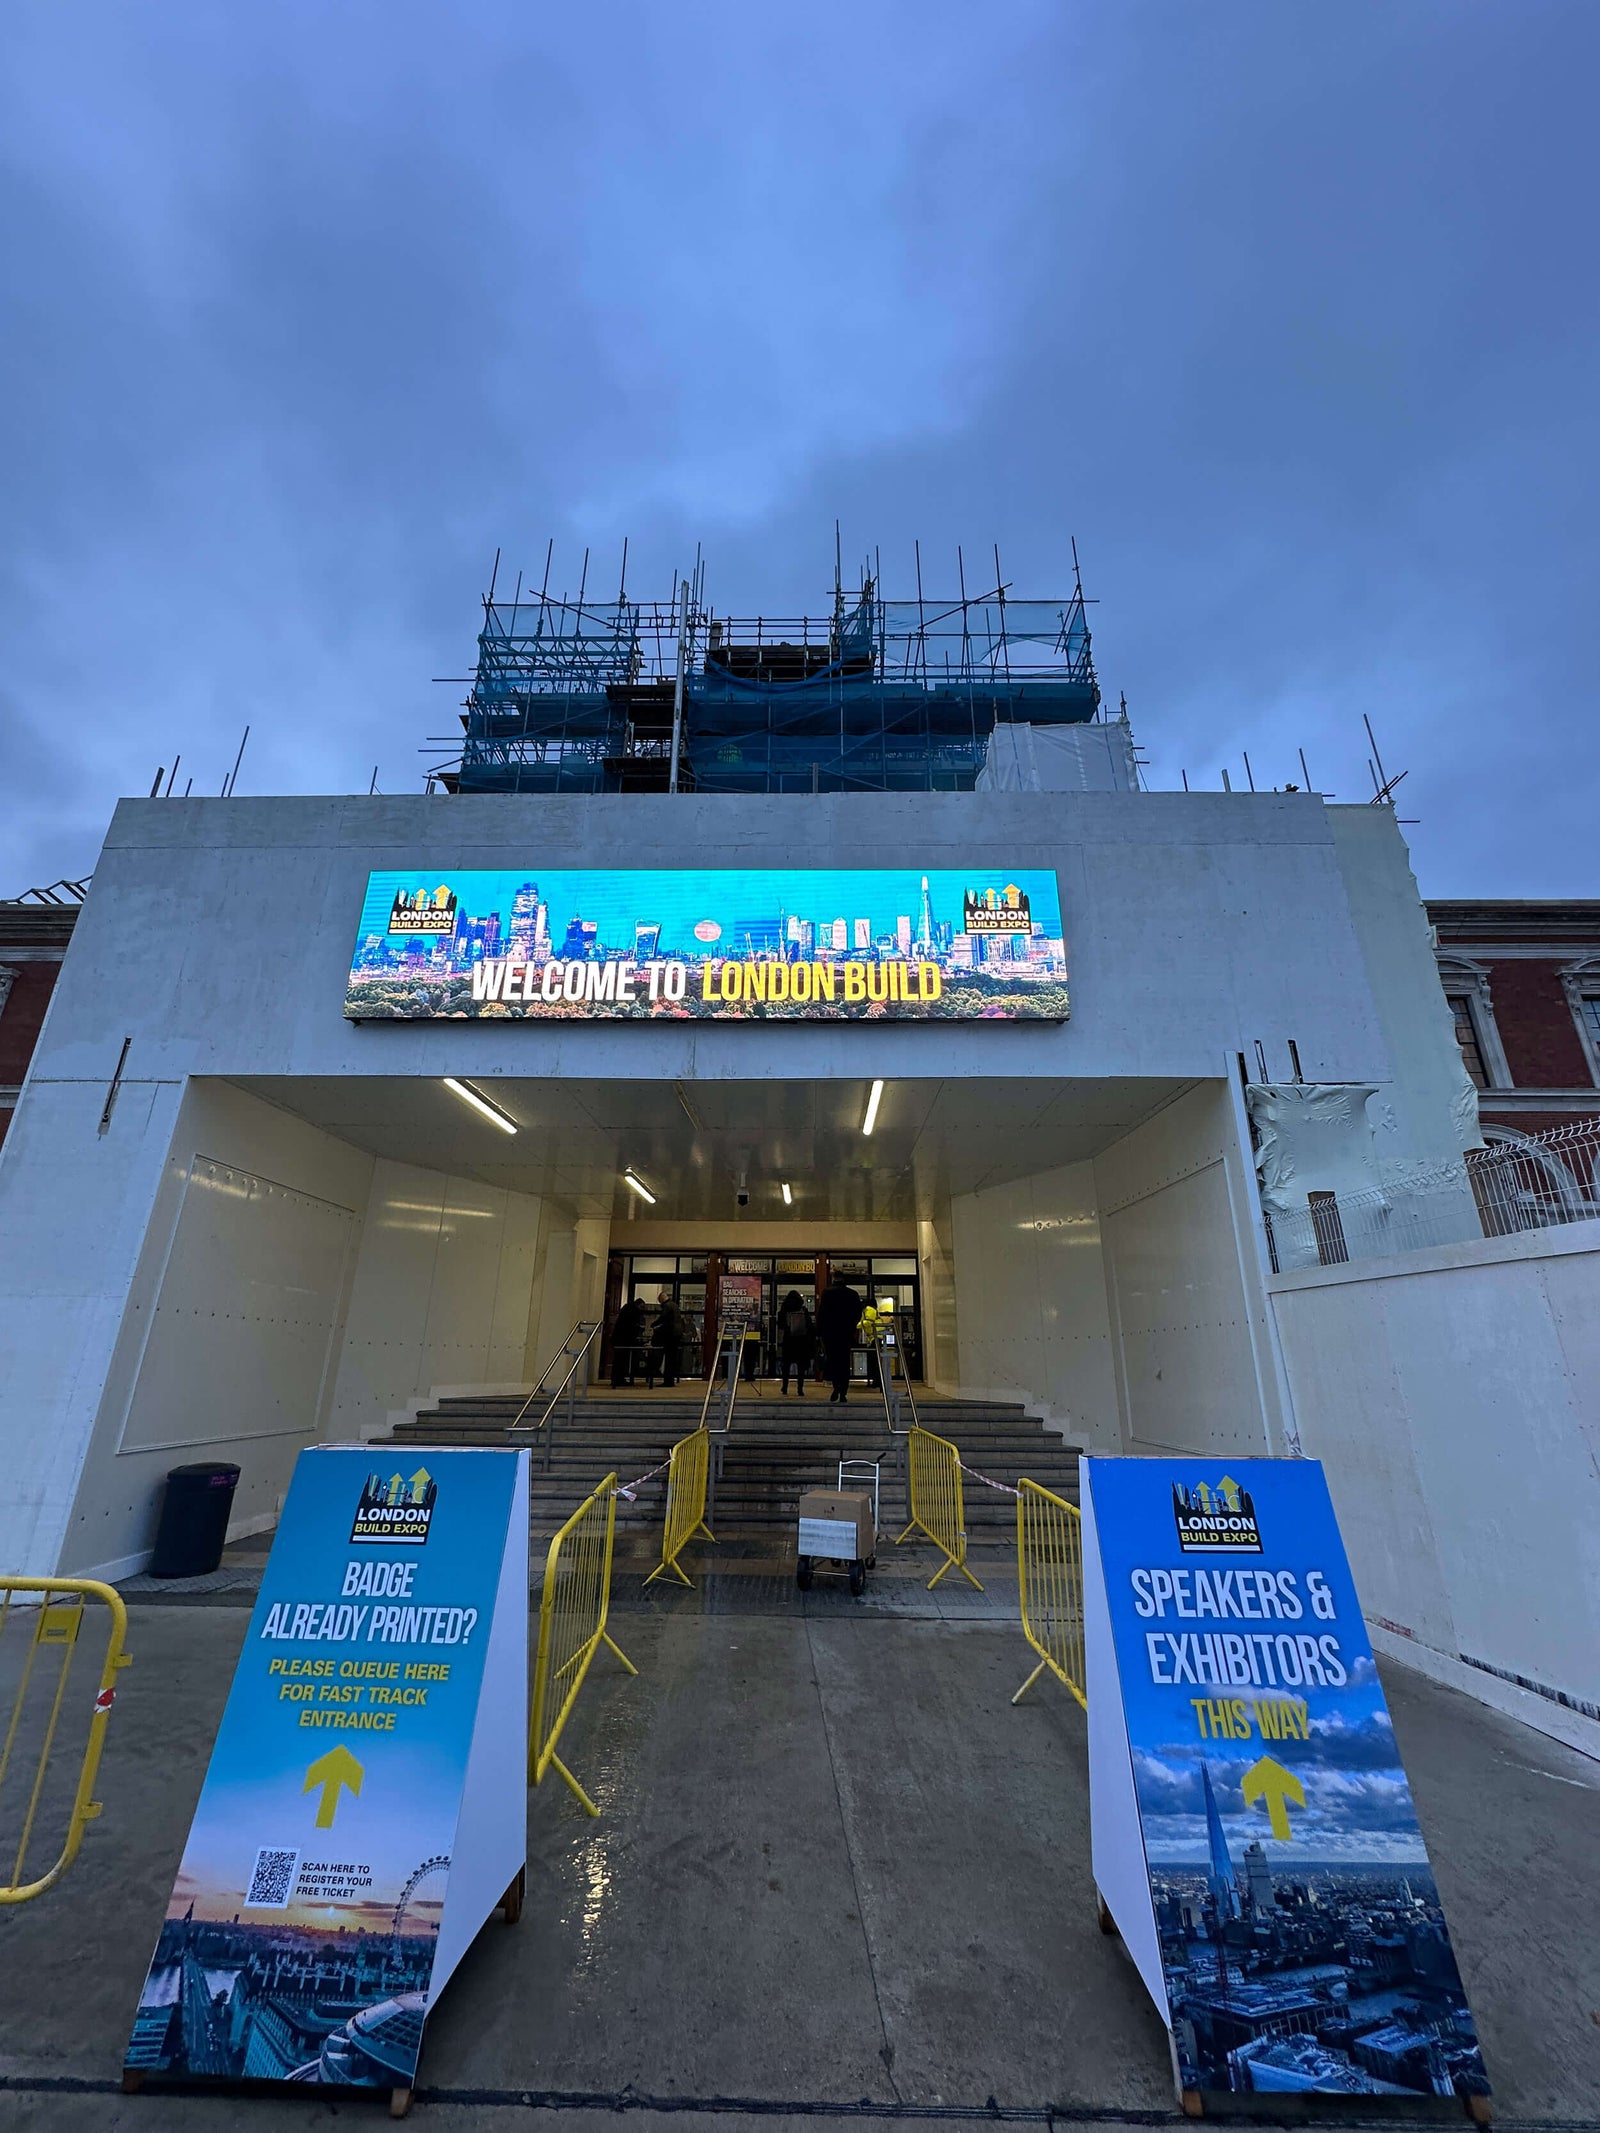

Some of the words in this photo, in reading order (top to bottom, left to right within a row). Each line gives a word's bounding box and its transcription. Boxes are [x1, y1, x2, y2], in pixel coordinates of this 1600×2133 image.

[392, 911, 454, 920] LONDON
[966, 911, 1029, 920] LONDON
[472, 961, 636, 1001] WELCOME
[648, 961, 686, 1001] TO
[702, 961, 836, 1001] LONDON
[844, 961, 942, 1001] BUILD
[356, 1508, 431, 1522] LONDON
[1178, 1516, 1256, 1531] LONDON
[354, 1523, 390, 1534] BUILD
[393, 1524, 428, 1534] EXPO
[1180, 1532, 1220, 1542] BUILD
[1222, 1532, 1258, 1543] EXPO
[341, 1561, 418, 1598] BADGE
[1130, 1568, 1303, 1620] SPEAKERS
[1306, 1571, 1336, 1620] &
[260, 1603, 369, 1642] ALREADY
[366, 1606, 478, 1645] PRINTED?
[1145, 1632, 1348, 1687] EXHIBITORS
[268, 1658, 336, 1677] PLEASE
[339, 1661, 400, 1680] QUEUE
[404, 1662, 450, 1681] HERE
[279, 1684, 314, 1700] FOR
[318, 1685, 364, 1703] FAST
[368, 1686, 428, 1706] TRACK
[298, 1709, 397, 1730] ENTRANCE
[1190, 1698, 1251, 1740] THIS
[1252, 1699, 1310, 1741] WAY
[301, 1862, 328, 1872] SCAN
[330, 1864, 355, 1874] HERE
[358, 1865, 370, 1874] TO
[299, 1874, 344, 1885] REGISTER
[347, 1876, 372, 1886] YOUR
[296, 1886, 320, 1896] FREE
[322, 1888, 355, 1898] TICKET
